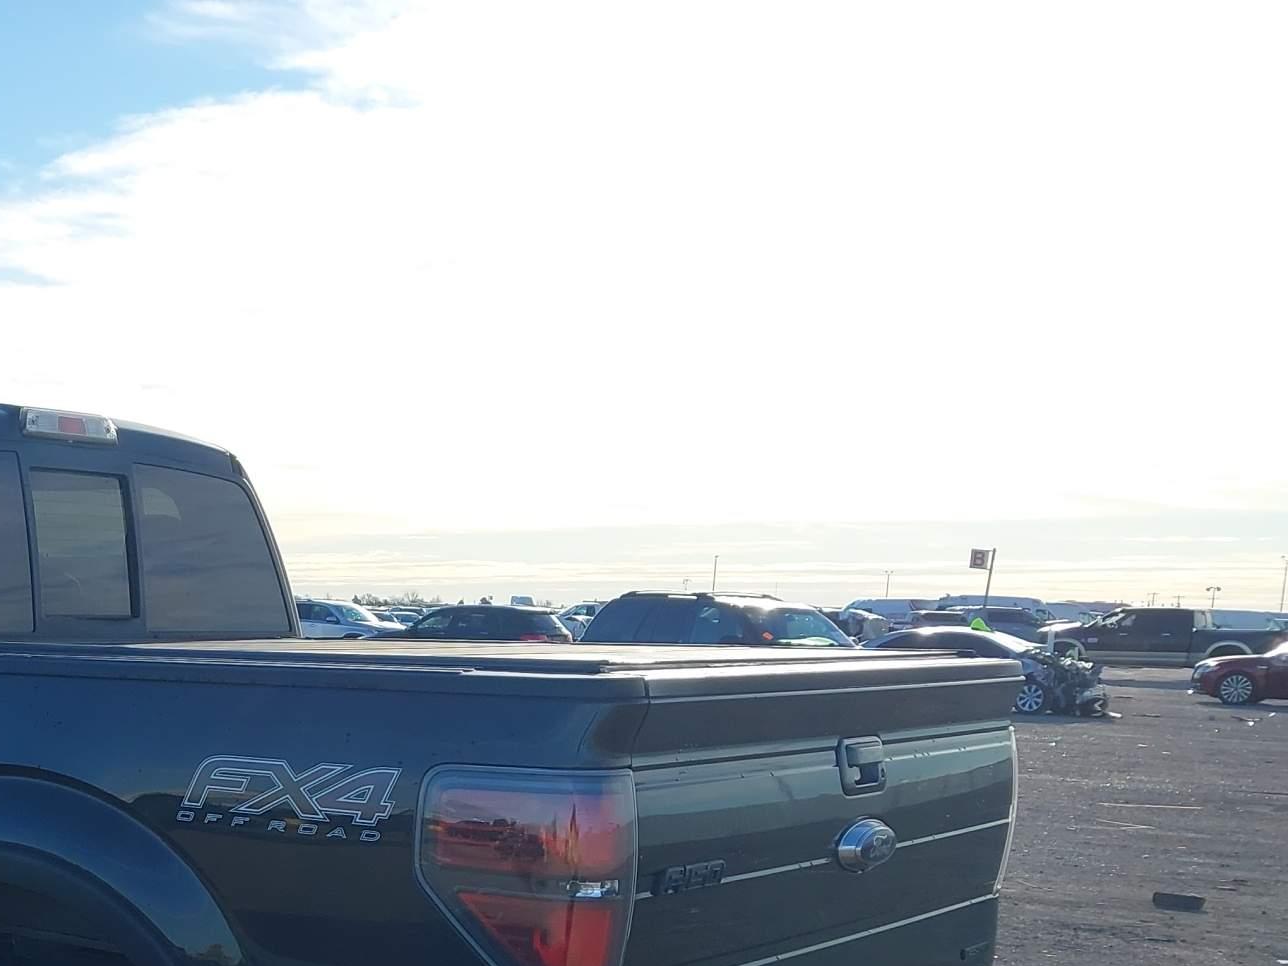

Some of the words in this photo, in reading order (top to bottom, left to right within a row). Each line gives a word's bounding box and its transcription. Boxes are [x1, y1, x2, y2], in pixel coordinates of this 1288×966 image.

[973, 551, 985, 566] B
[180, 754, 403, 827] FX4
[175, 810, 251, 827] OFF
[267, 820, 383, 842] ROAD
